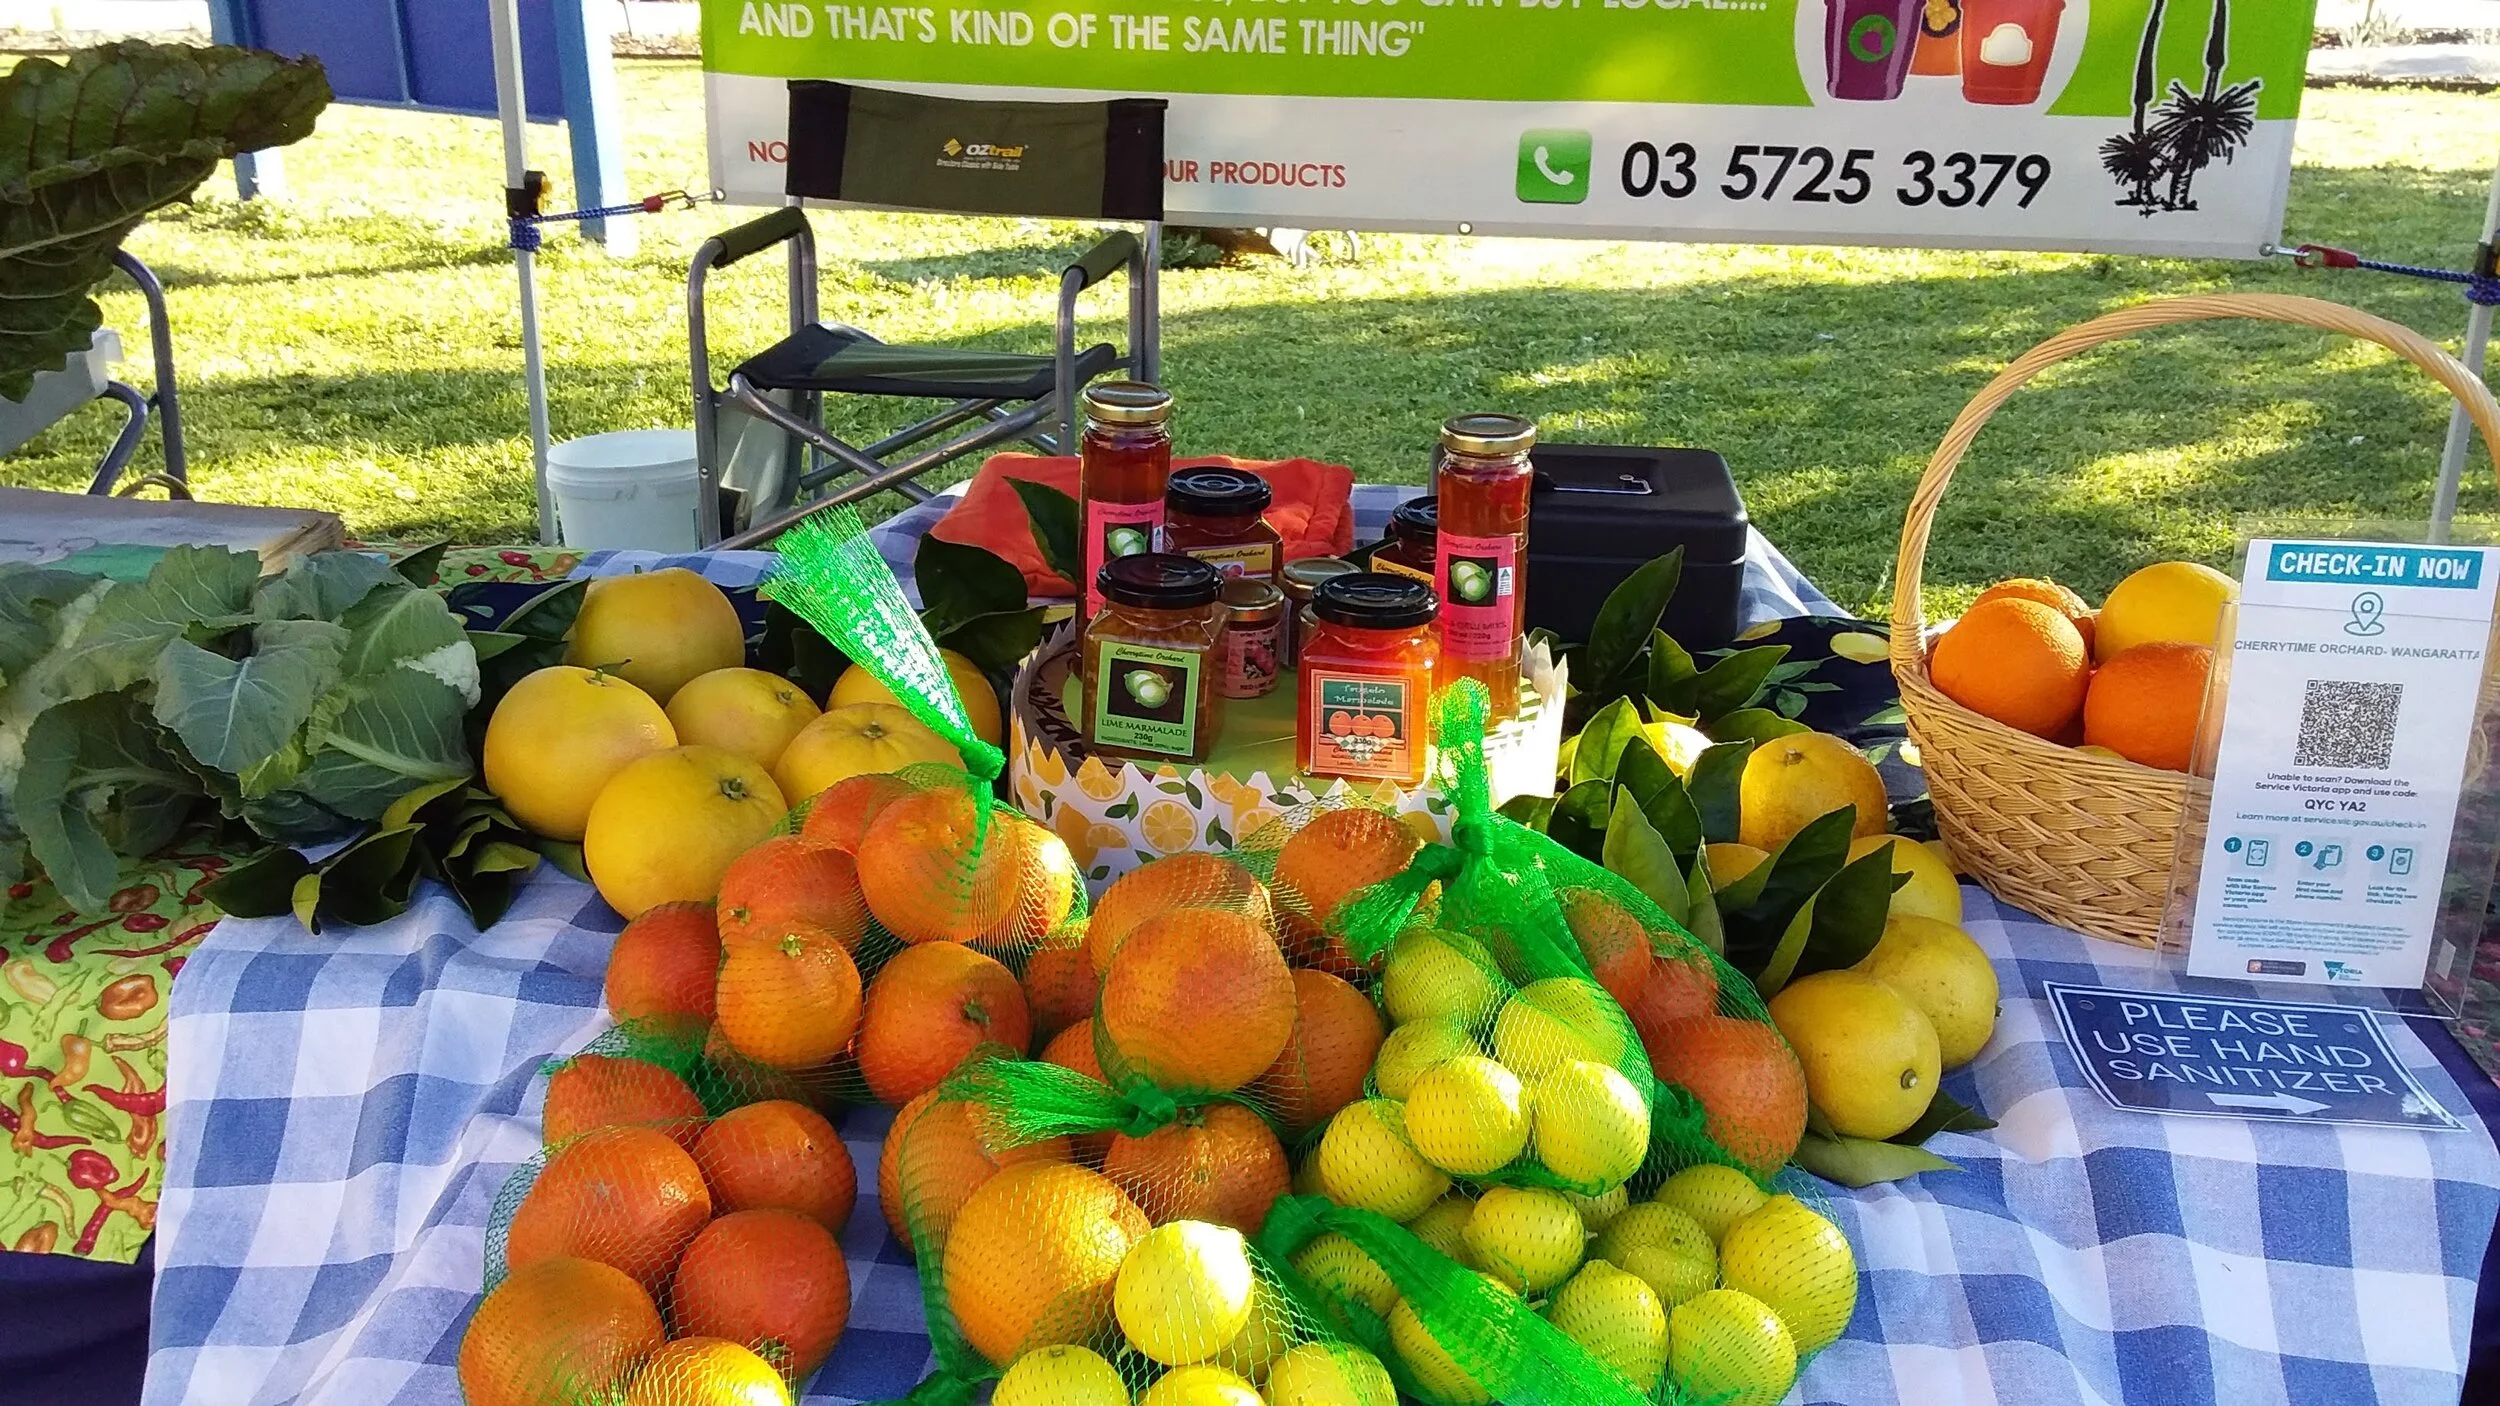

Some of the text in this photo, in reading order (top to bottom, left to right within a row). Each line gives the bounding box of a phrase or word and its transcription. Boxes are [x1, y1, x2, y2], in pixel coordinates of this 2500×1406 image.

[739, 2, 1424, 57] AND THAT'S KIND OF THE SAME THING"
[1210, 161, 1346, 187] PRODUCTS
[1620, 140, 2052, 209] 03 5725 3379
[2279, 551, 2471, 580] CHECK-IN NOW
[1115, 647, 1185, 663] Cherrytime Orchard
[2234, 640, 2316, 653] CHERRYTIME
[1102, 719, 1187, 737] LIME MARMALADE
[1134, 732, 1153, 742] 230g
[2255, 782, 2290, 791] Service
[2293, 784, 2330, 793] Victoria
[2332, 787, 2351, 795] app
[2353, 787, 2371, 795] and
[2267, 773, 2409, 787] Unable to scan? Download the
[2305, 799, 2366, 812] QYC YA2
[2236, 812, 2264, 820] Learn
[2119, 1001, 2319, 1038] PLEASE
[2092, 1029, 2374, 1069] USE HAND
[2108, 1059, 2397, 1096] SANITIZER
